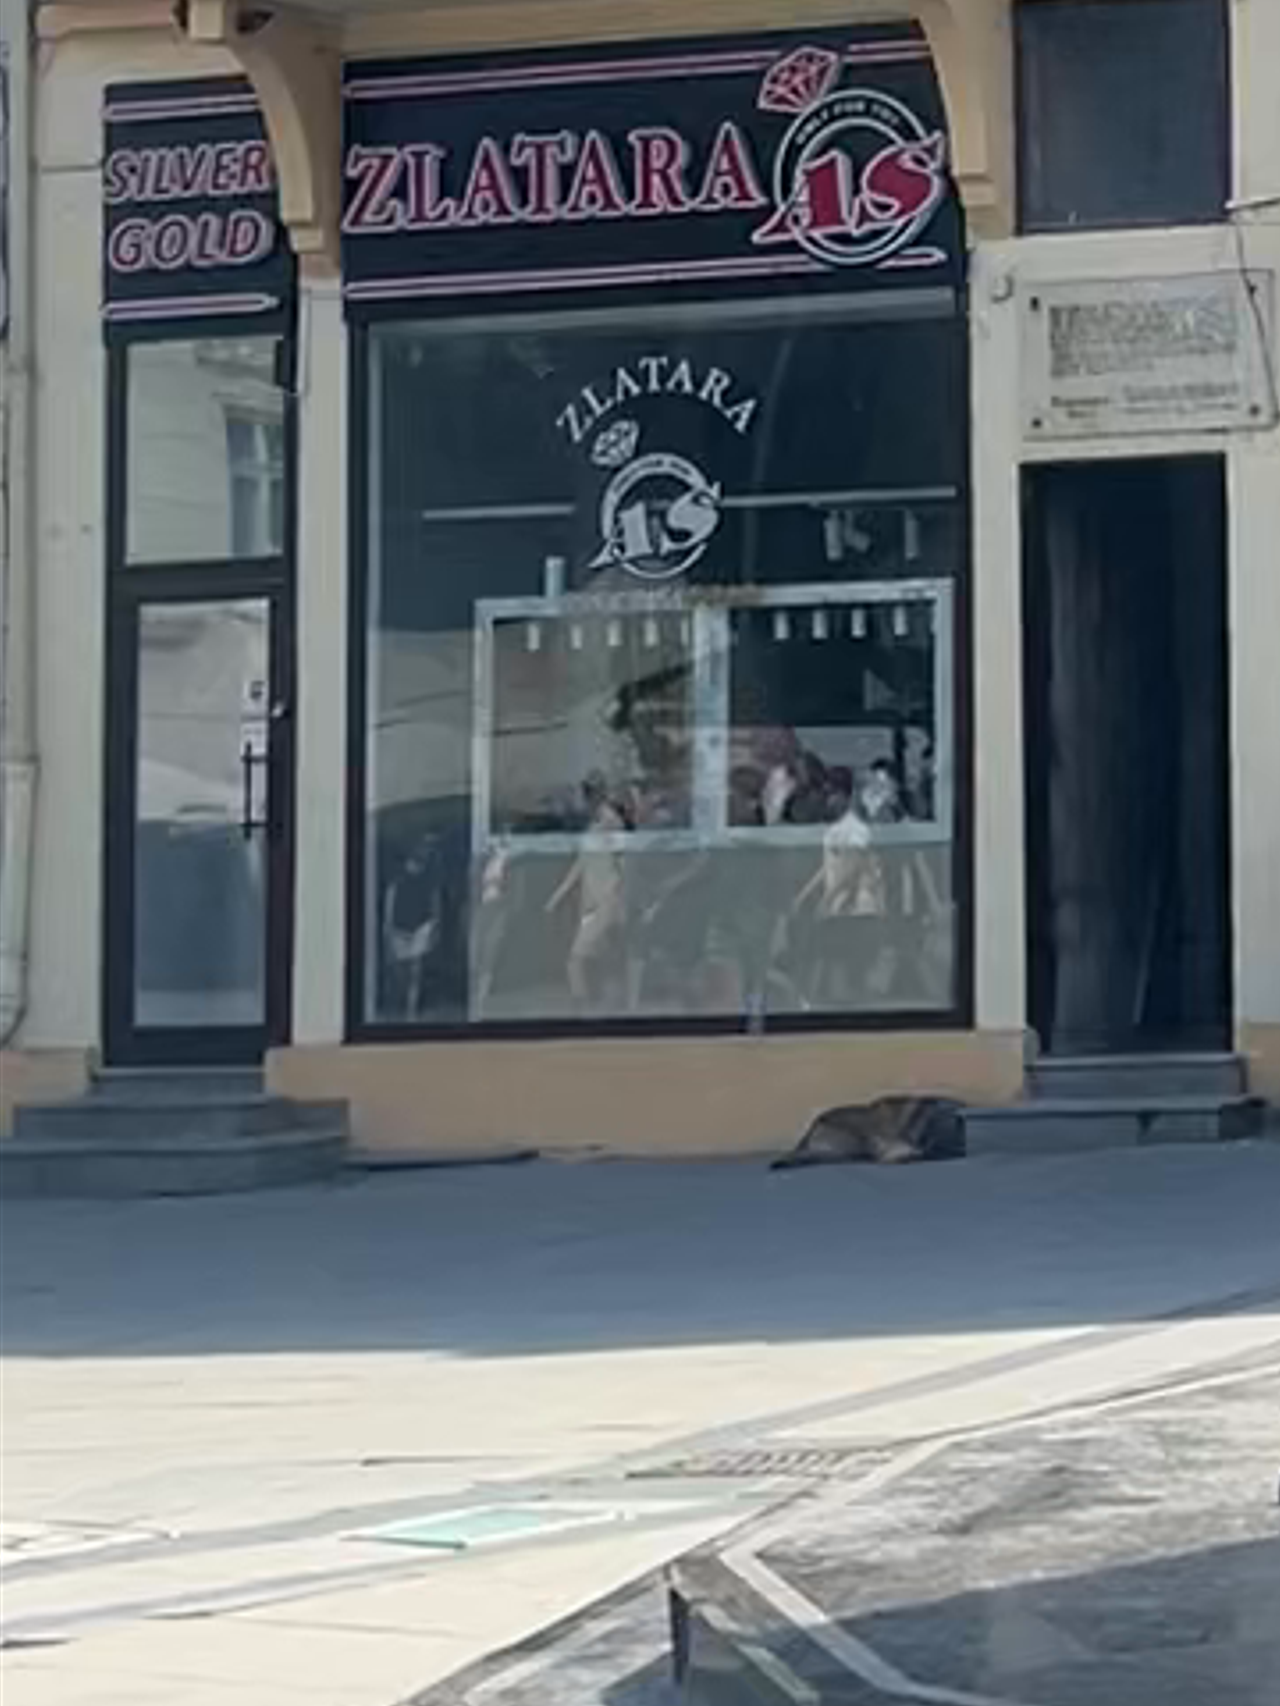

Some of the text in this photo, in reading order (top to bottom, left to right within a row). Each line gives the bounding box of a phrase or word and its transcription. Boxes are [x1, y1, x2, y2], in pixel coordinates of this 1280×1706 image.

[103, 139, 271, 203] SILVER
[341, 121, 769, 233] ZLATARA
[109, 209, 275, 274] GOLD
[555, 355, 757, 444] ZLATARA
